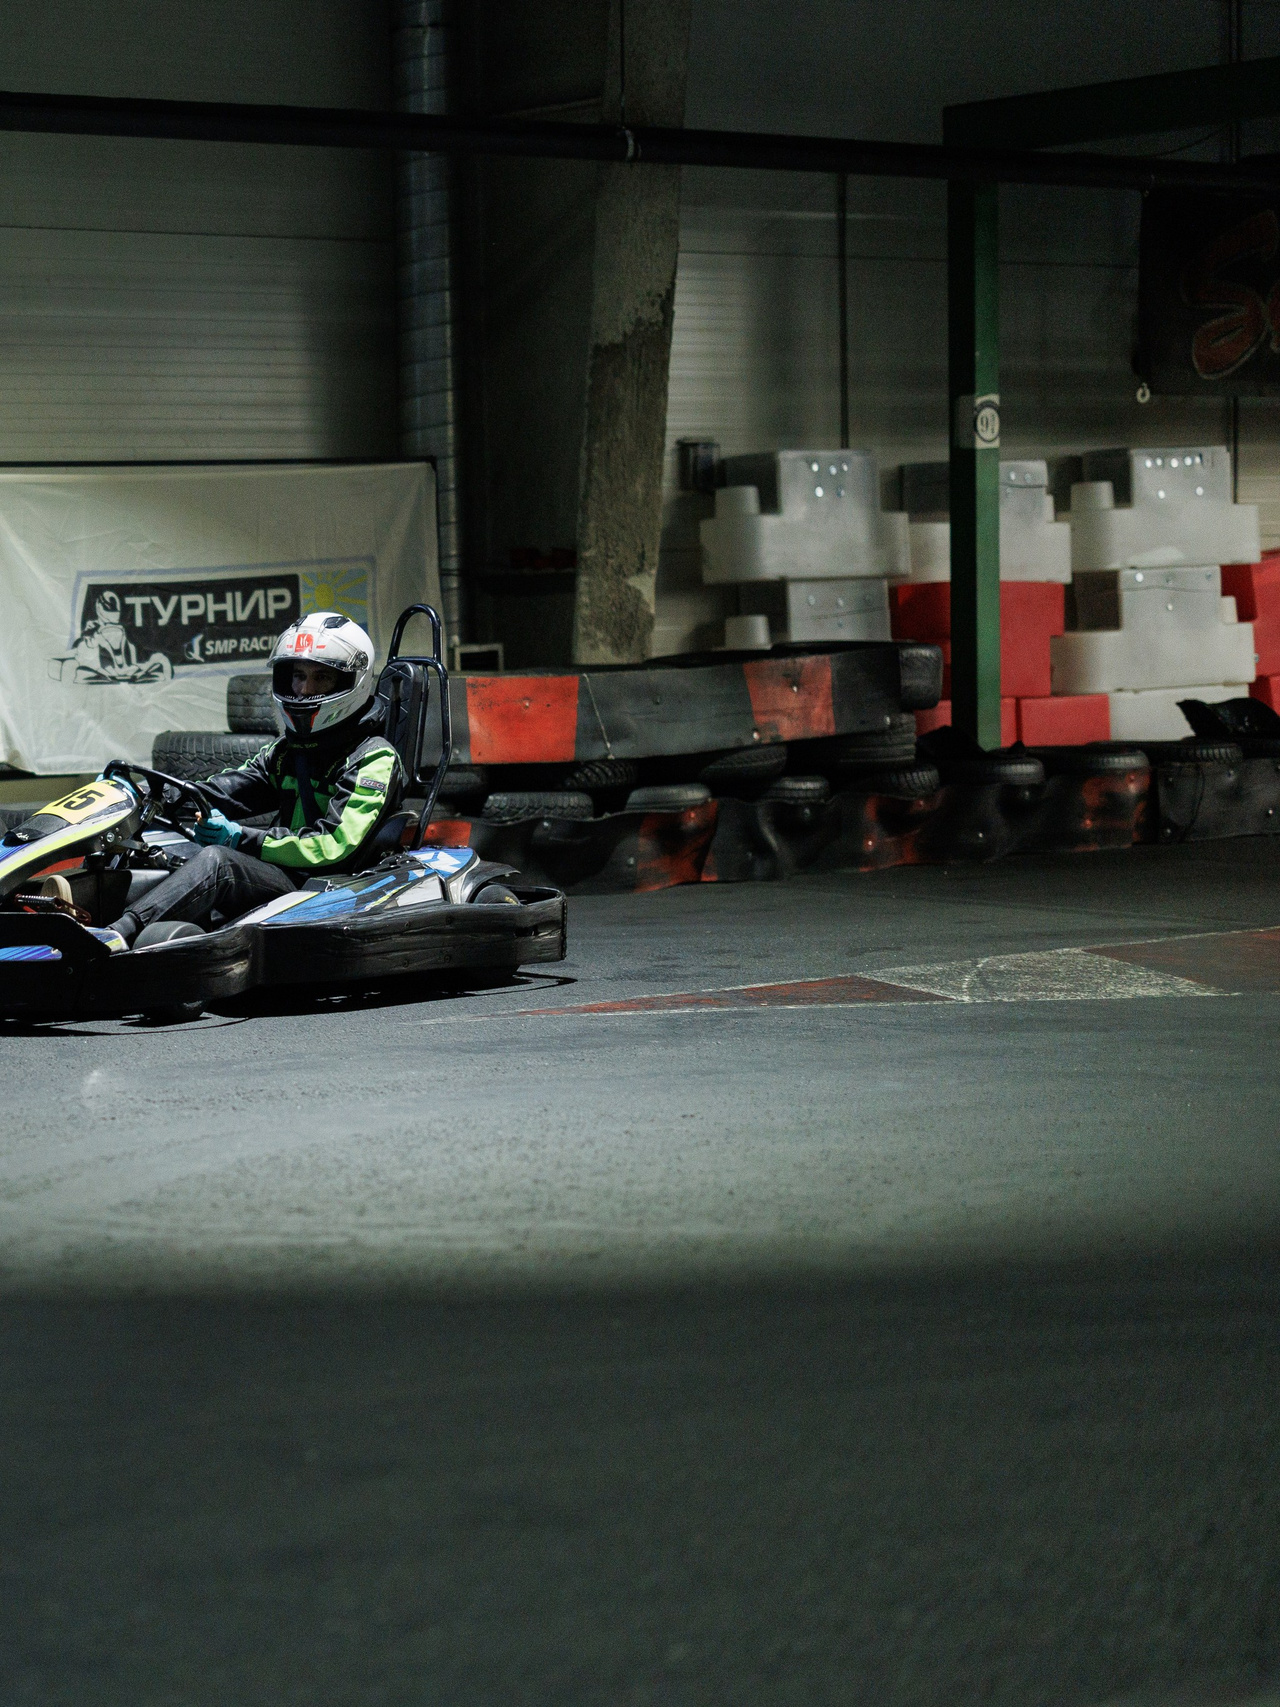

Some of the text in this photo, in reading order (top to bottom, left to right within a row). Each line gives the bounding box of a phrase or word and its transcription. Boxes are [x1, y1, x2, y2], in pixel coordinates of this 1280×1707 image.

[125, 588, 293, 628] ТУРНИР
[205, 638, 239, 655] SMP
[53, 788, 105, 811] 15
